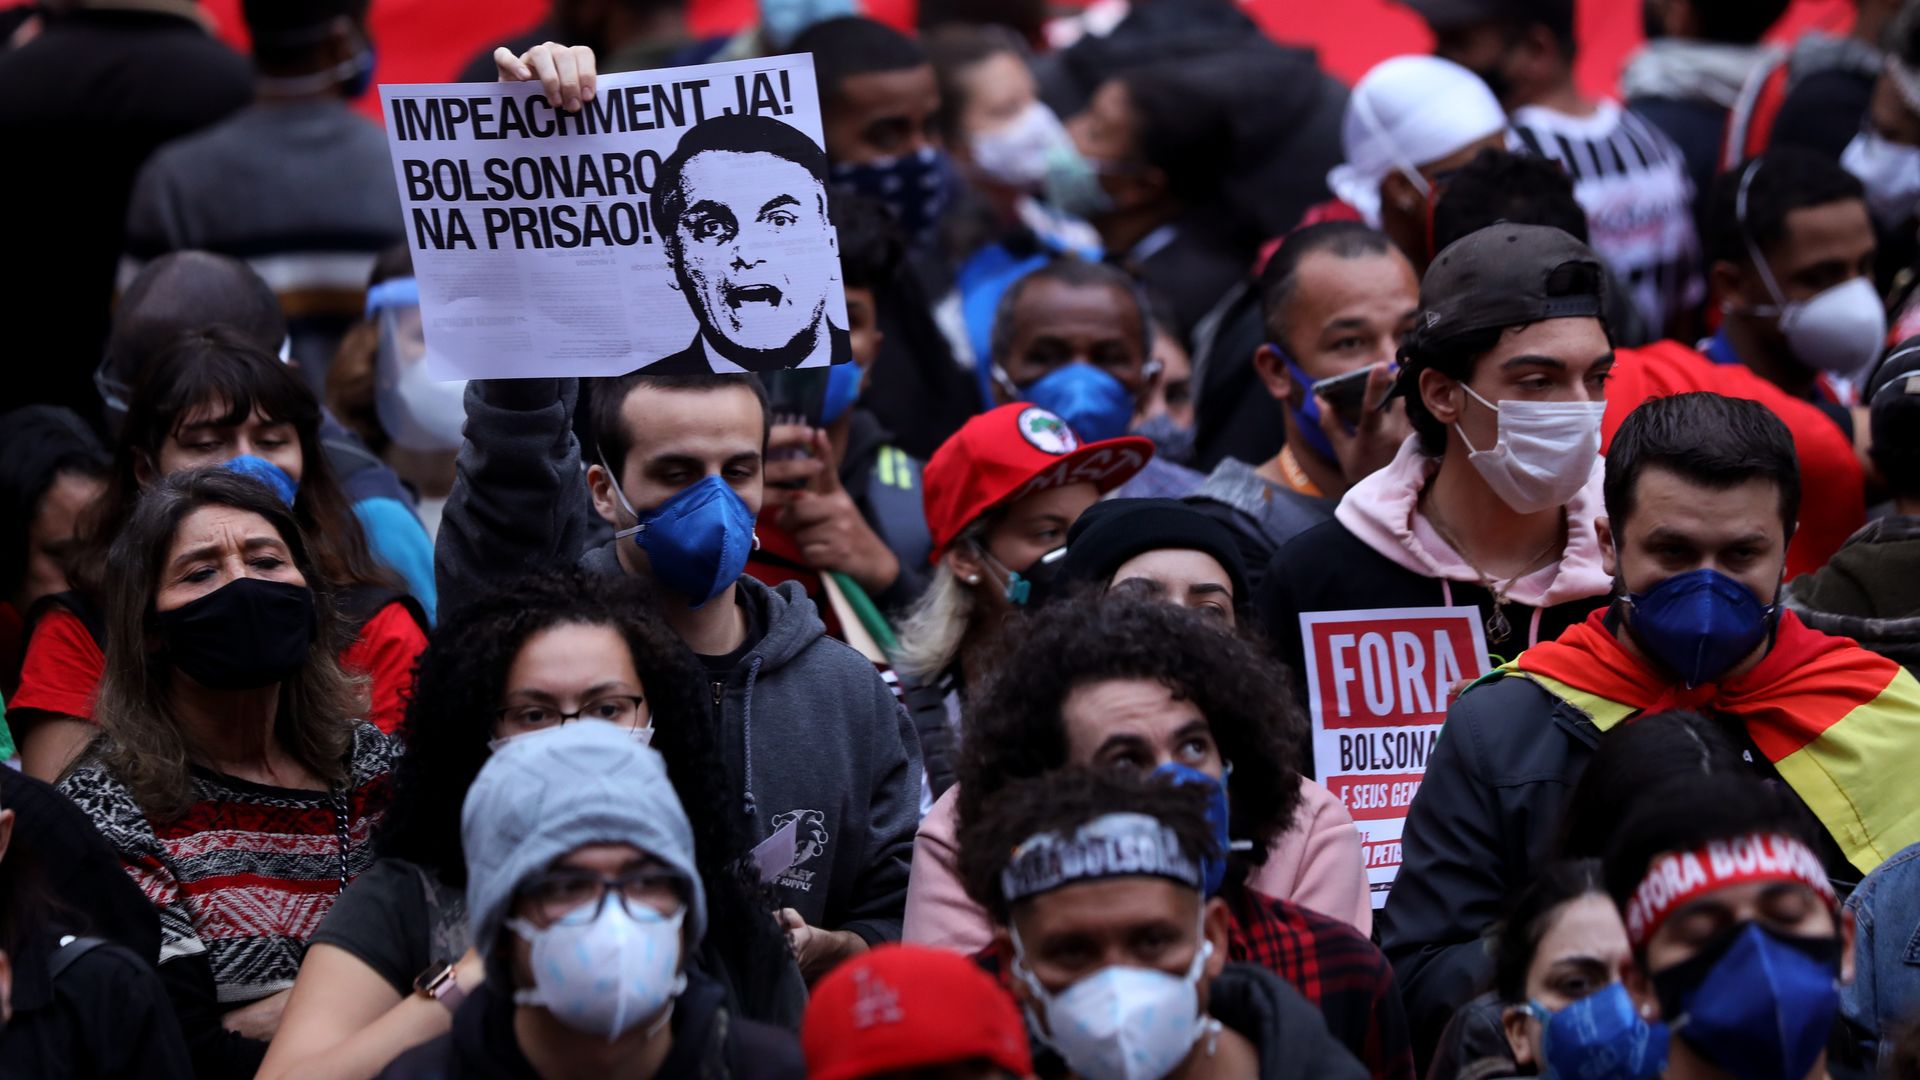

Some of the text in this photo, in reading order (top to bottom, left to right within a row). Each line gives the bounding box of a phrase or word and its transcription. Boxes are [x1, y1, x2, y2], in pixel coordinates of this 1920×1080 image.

[391, 79, 710, 141] IMPEACHMENT
[402, 149, 661, 202] BOLSONARO
[412, 208, 477, 250] NA
[1329, 630, 1464, 718] FORA
[1352, 783, 1389, 810] SEUS
